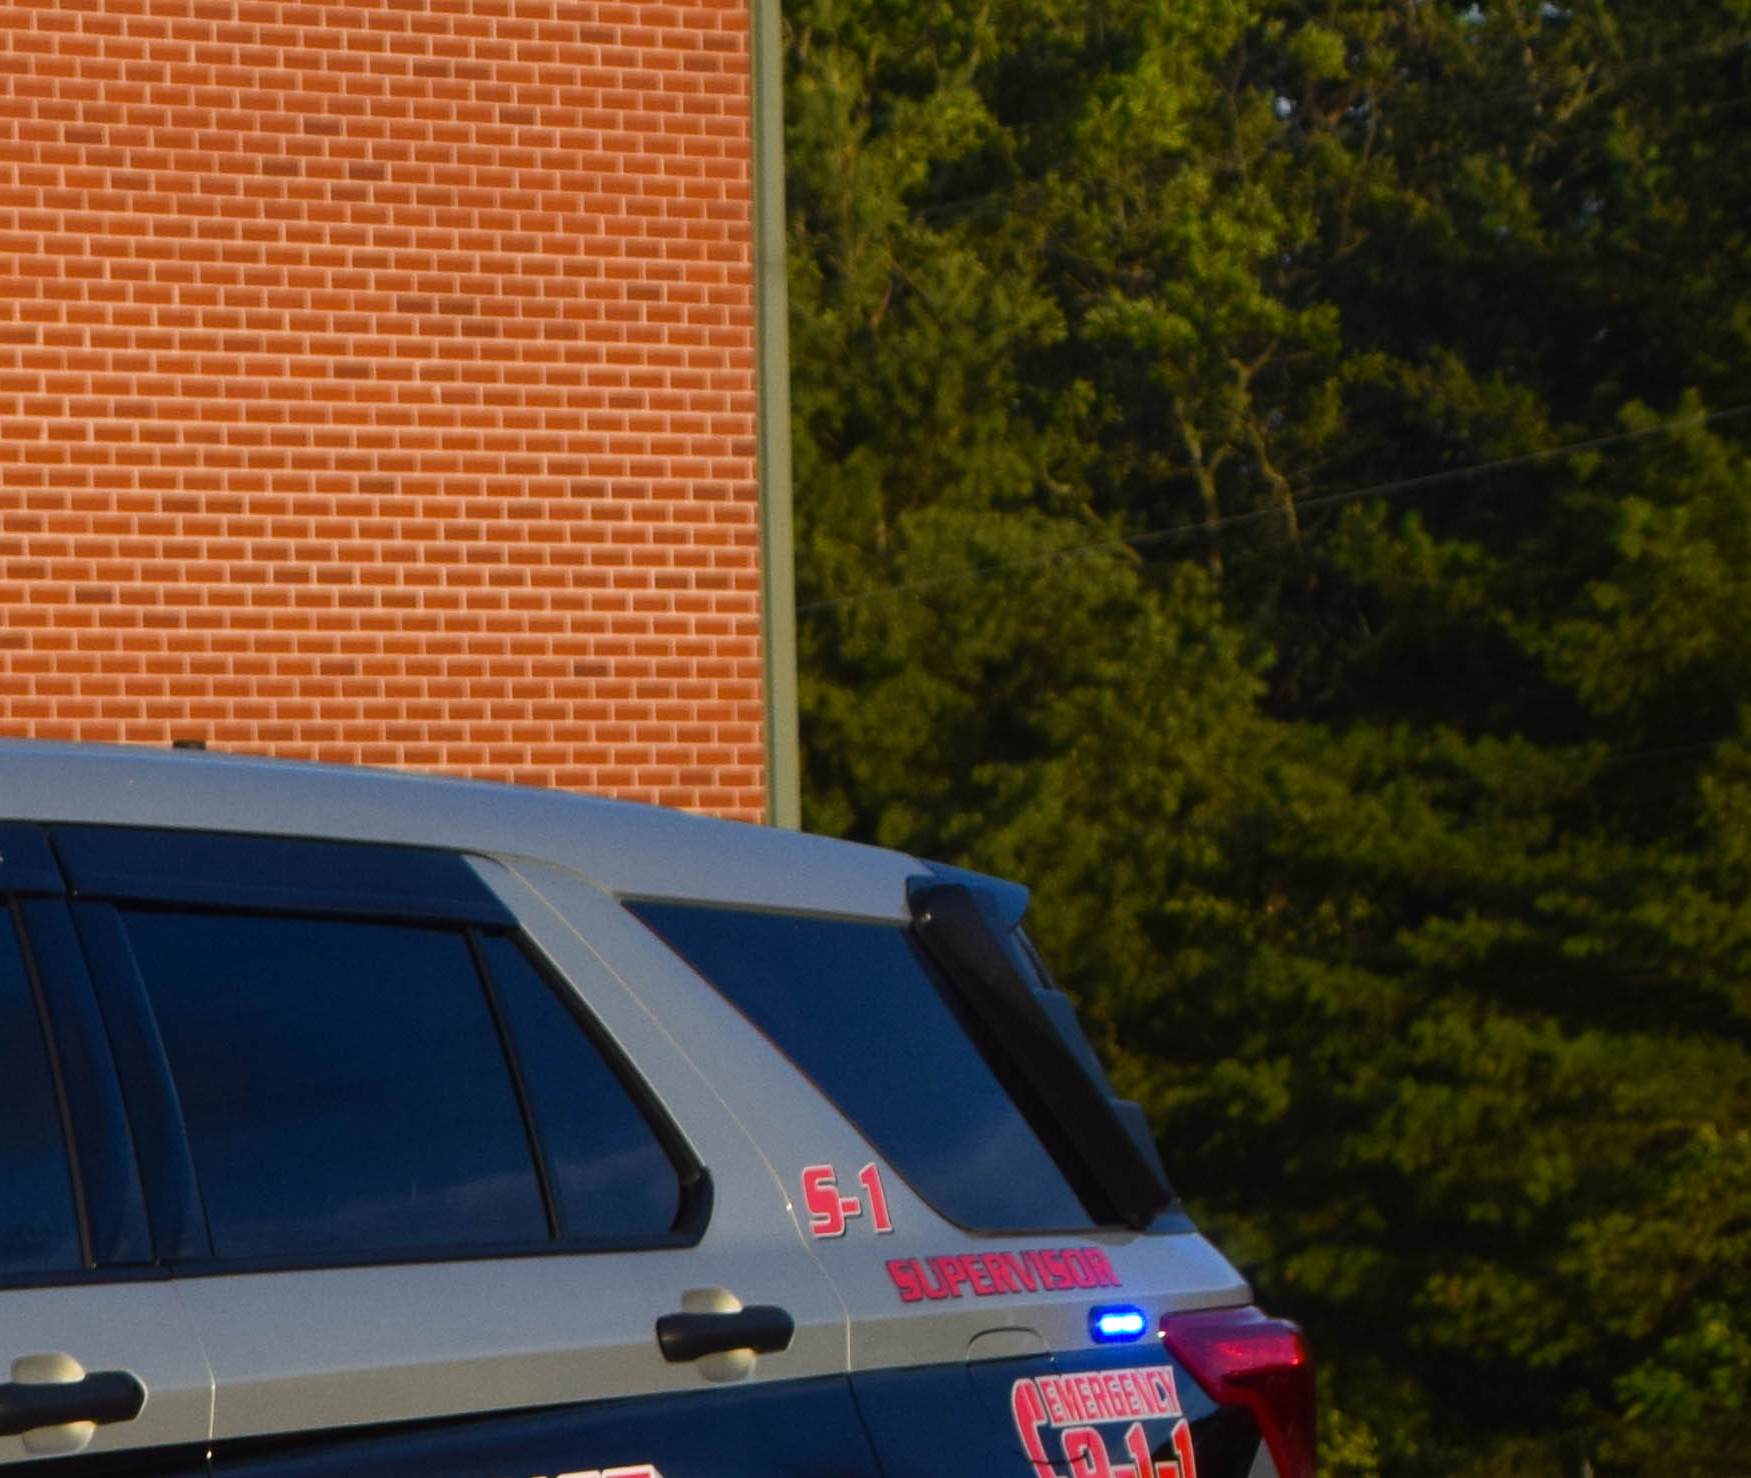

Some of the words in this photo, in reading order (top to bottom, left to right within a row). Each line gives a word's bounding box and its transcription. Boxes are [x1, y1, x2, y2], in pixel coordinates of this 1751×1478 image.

[801, 1162, 894, 1238] S-1
[886, 1247, 1122, 1303] SUPERVISOR
[1038, 1368, 1181, 1425] EMERGENCY
